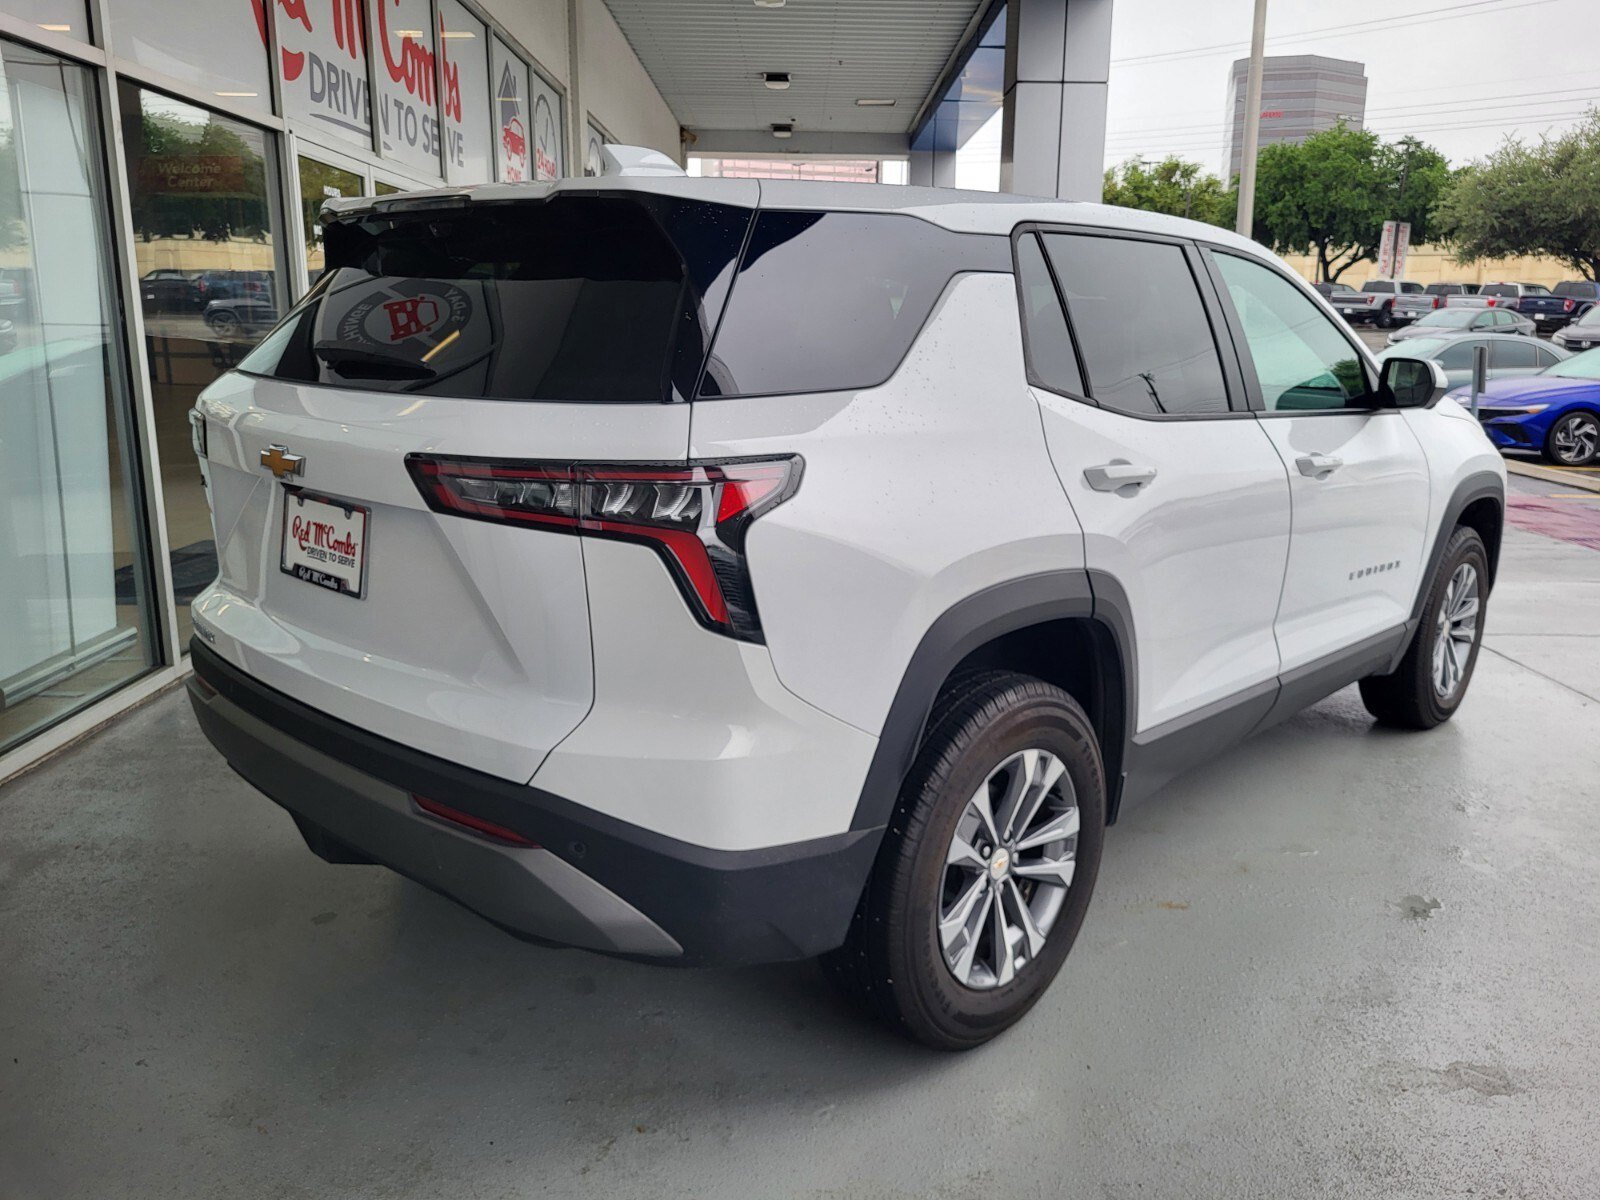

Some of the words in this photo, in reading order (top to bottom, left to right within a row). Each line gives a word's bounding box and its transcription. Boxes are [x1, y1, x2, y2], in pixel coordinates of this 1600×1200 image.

[394, 98, 418, 147] TO
[422, 113, 464, 168] SEVE
[160, 162, 221, 175] Welcome
[168, 175, 216, 188] Center
[292, 515, 311, 551] Red
[311, 520, 357, 558] McCombs
[306, 546, 328, 560] DRIVEN
[328, 552, 337, 563] TO
[337, 554, 356, 569] SERVE
